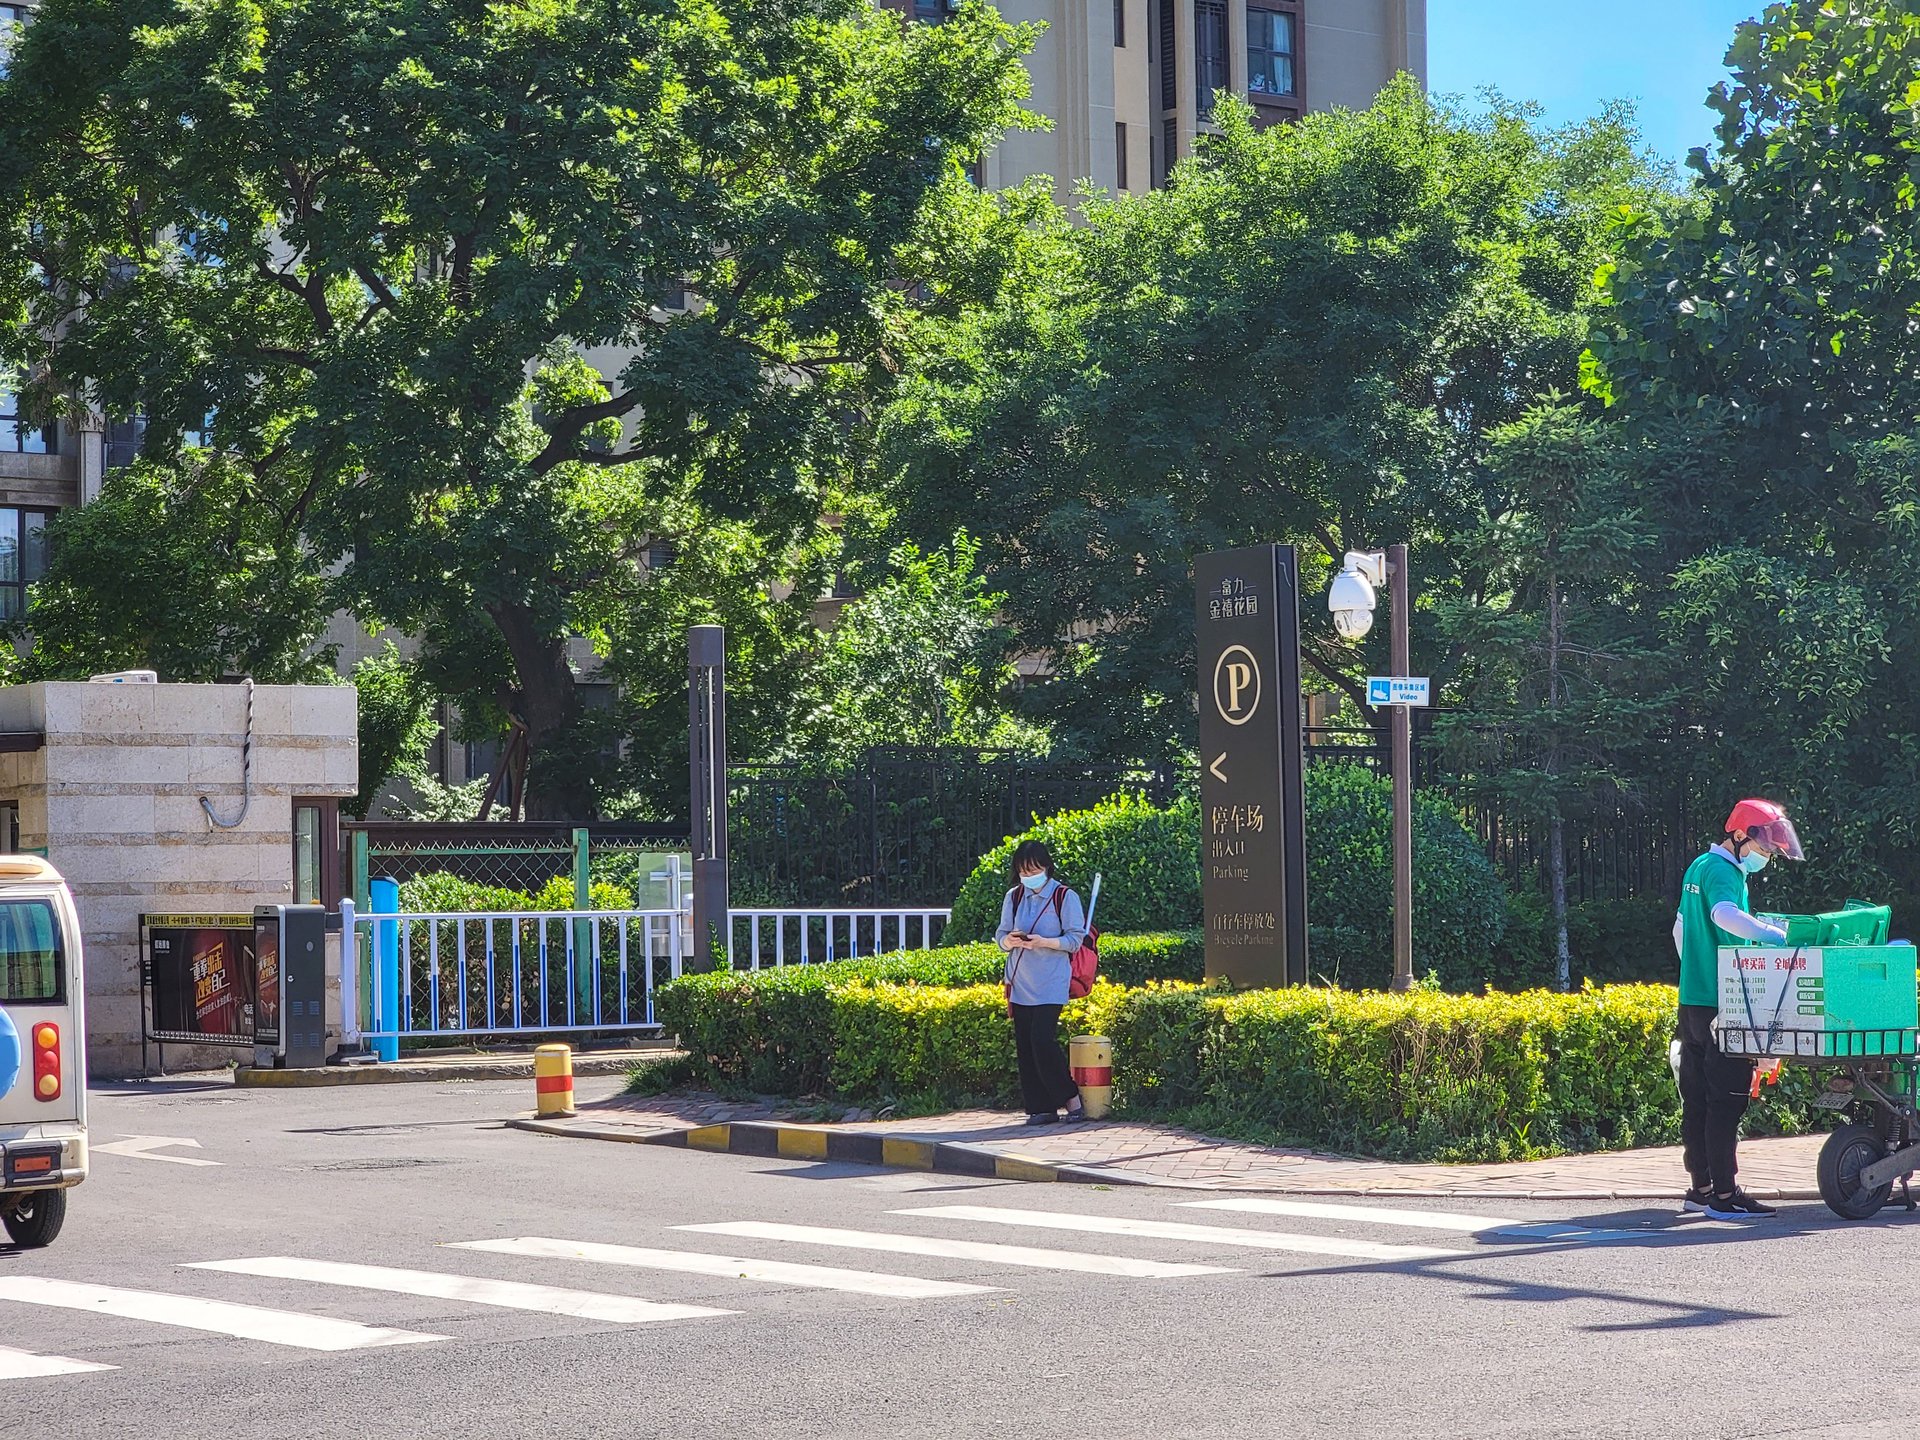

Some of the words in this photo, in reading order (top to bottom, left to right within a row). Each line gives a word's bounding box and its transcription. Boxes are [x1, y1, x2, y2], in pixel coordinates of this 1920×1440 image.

[1221, 577, 1244, 595] 富力
[1209, 595, 1258, 620] 金禧花园
[1225, 663, 1251, 712] P
[1399, 693, 1418, 701] Video
[1211, 804, 1264, 835] 停车场
[1212, 838, 1245, 858] 出入口
[1213, 864, 1249, 882] Parking
[1213, 912, 1275, 931] 自行车停放处
[1214, 933, 1243, 948] Bicycle
[190, 951, 222, 982] 重拳出击
